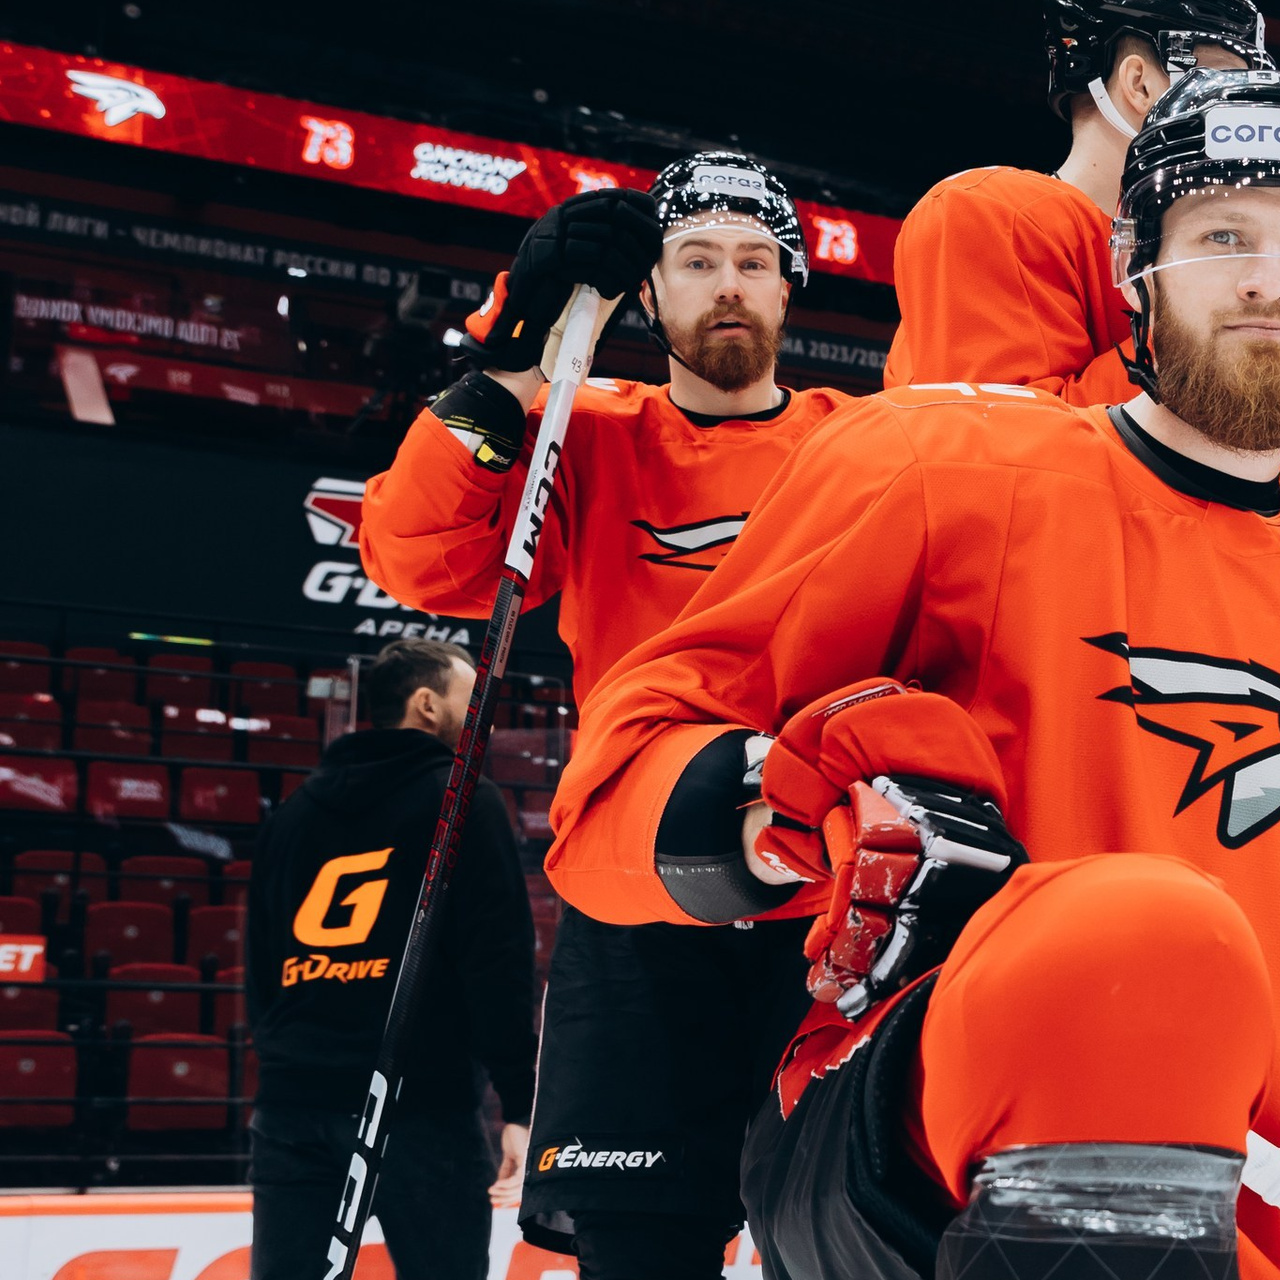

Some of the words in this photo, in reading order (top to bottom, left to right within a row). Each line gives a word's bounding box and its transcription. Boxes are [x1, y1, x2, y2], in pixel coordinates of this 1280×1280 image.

[301, 115, 355, 170] 73
[46, 210, 109, 240] ЛИГИ
[131, 224, 268, 267] ЧЕМПИОНАТ
[273, 249, 357, 280] РОССИИ
[362, 264, 391, 288] ПО
[811, 215, 860, 266] 73
[570, 356, 583, 374] 43
[809, 339, 888, 370] 2023/202
[522, 440, 561, 559] CCM
[353, 618, 471, 645] АРЕНА
